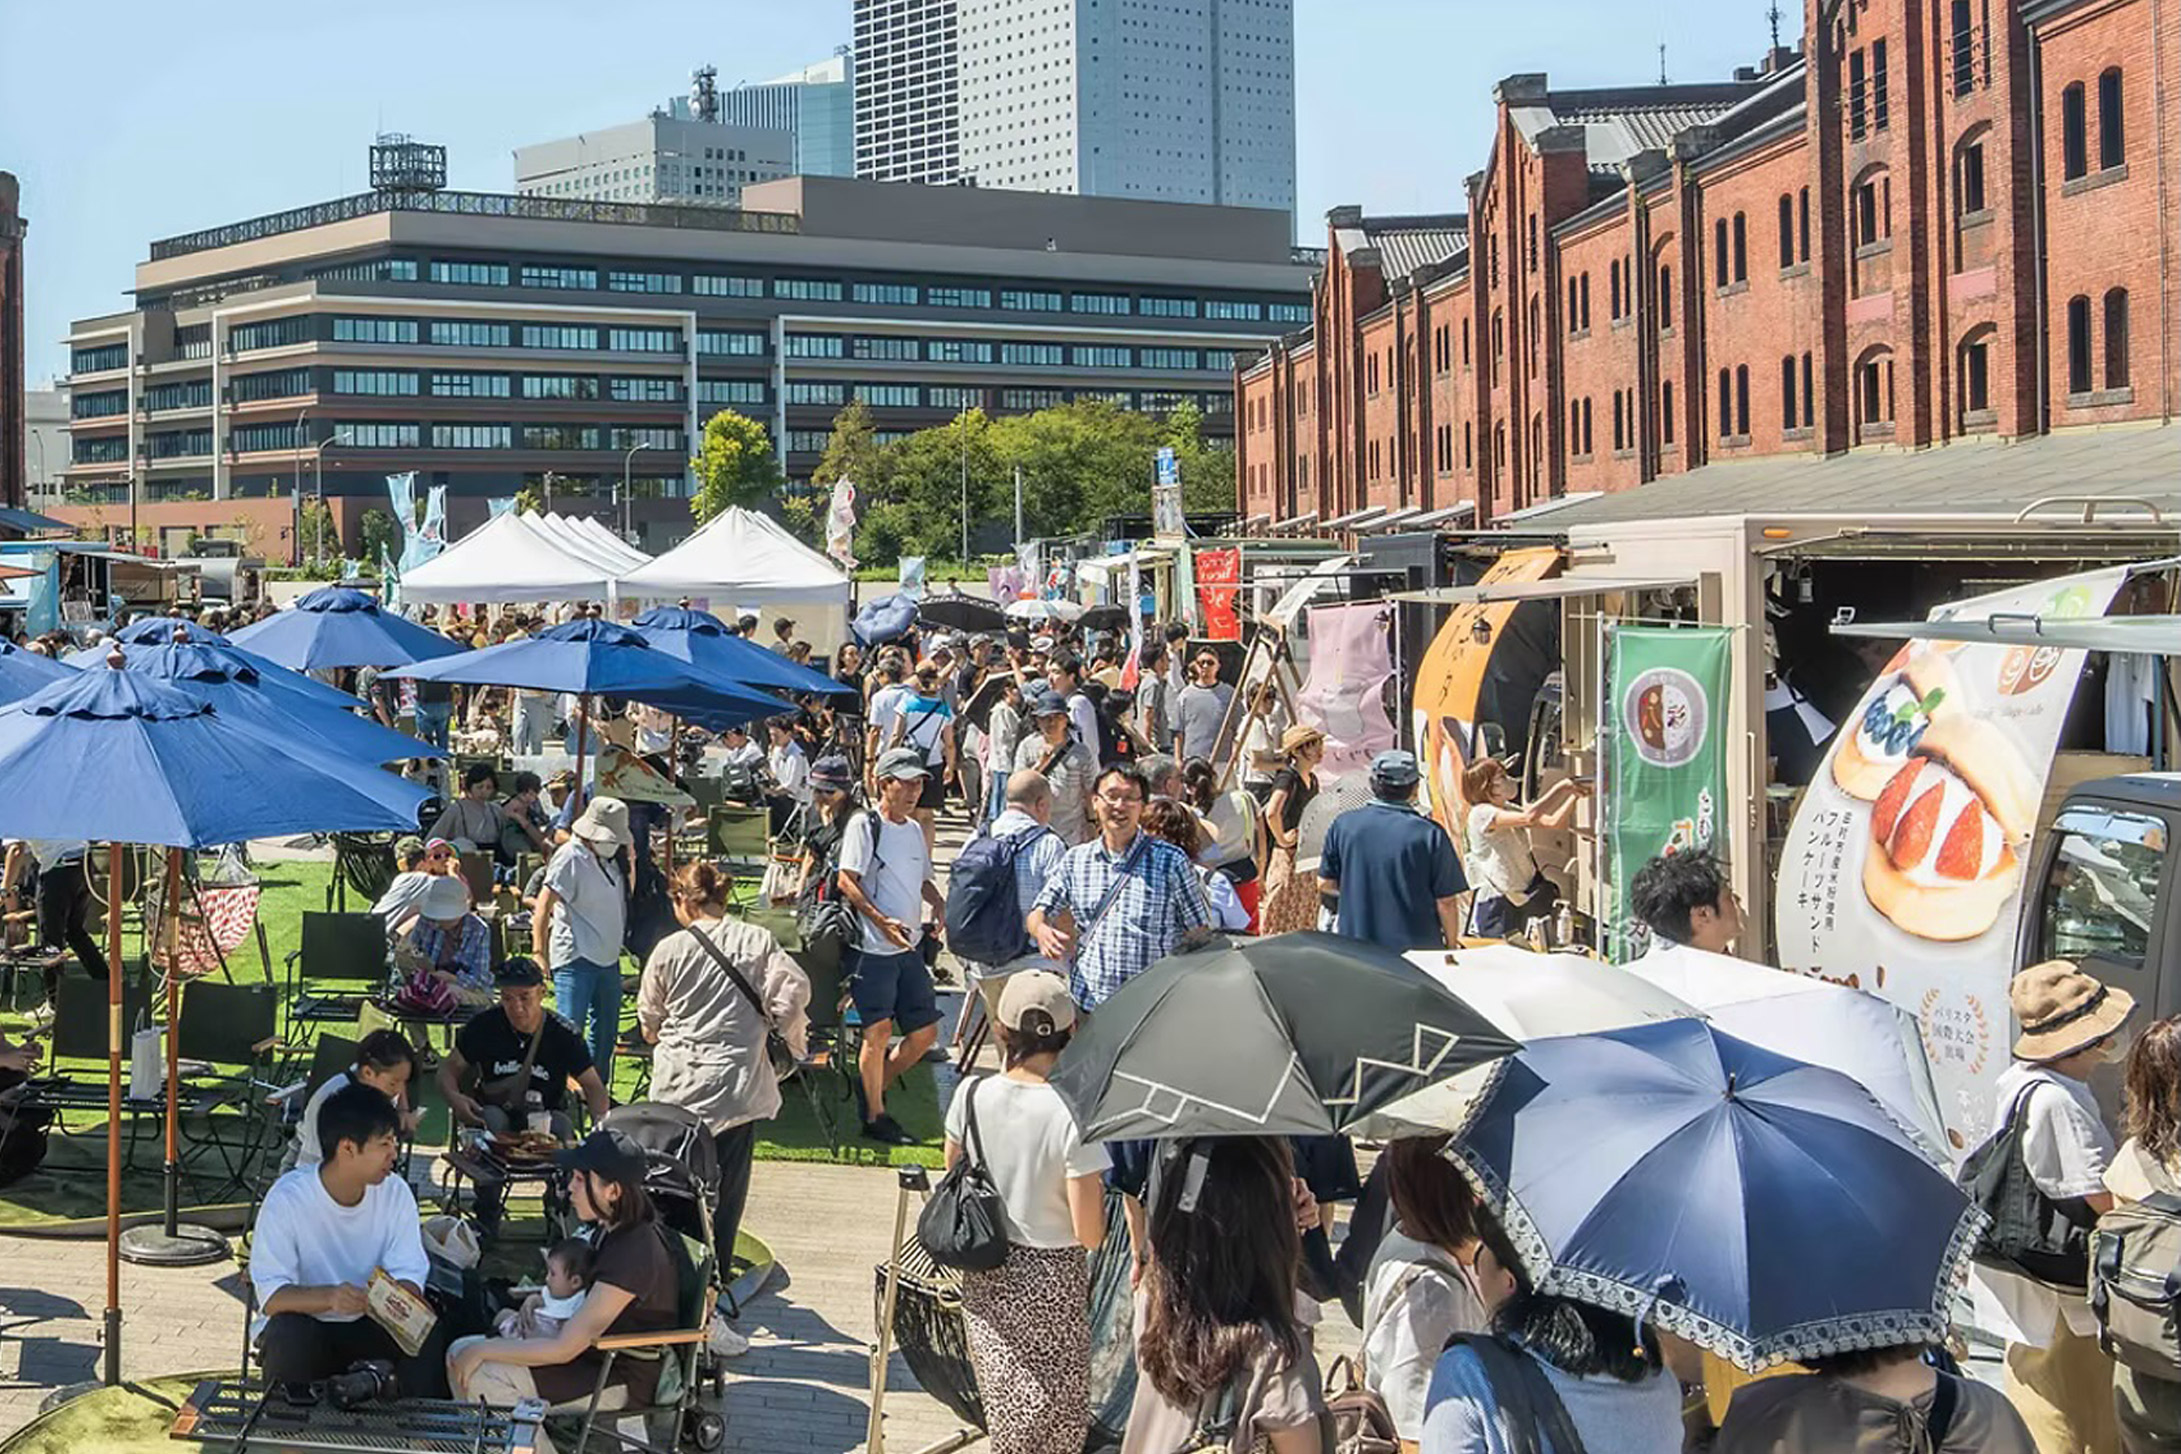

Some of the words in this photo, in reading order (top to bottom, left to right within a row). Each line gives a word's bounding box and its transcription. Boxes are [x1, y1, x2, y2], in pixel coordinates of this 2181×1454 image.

[1797, 812, 1826, 908] パンケーキ
[1811, 812, 1838, 953] フルーツサンド
[1935, 1007, 1972, 1023] バリスタ
